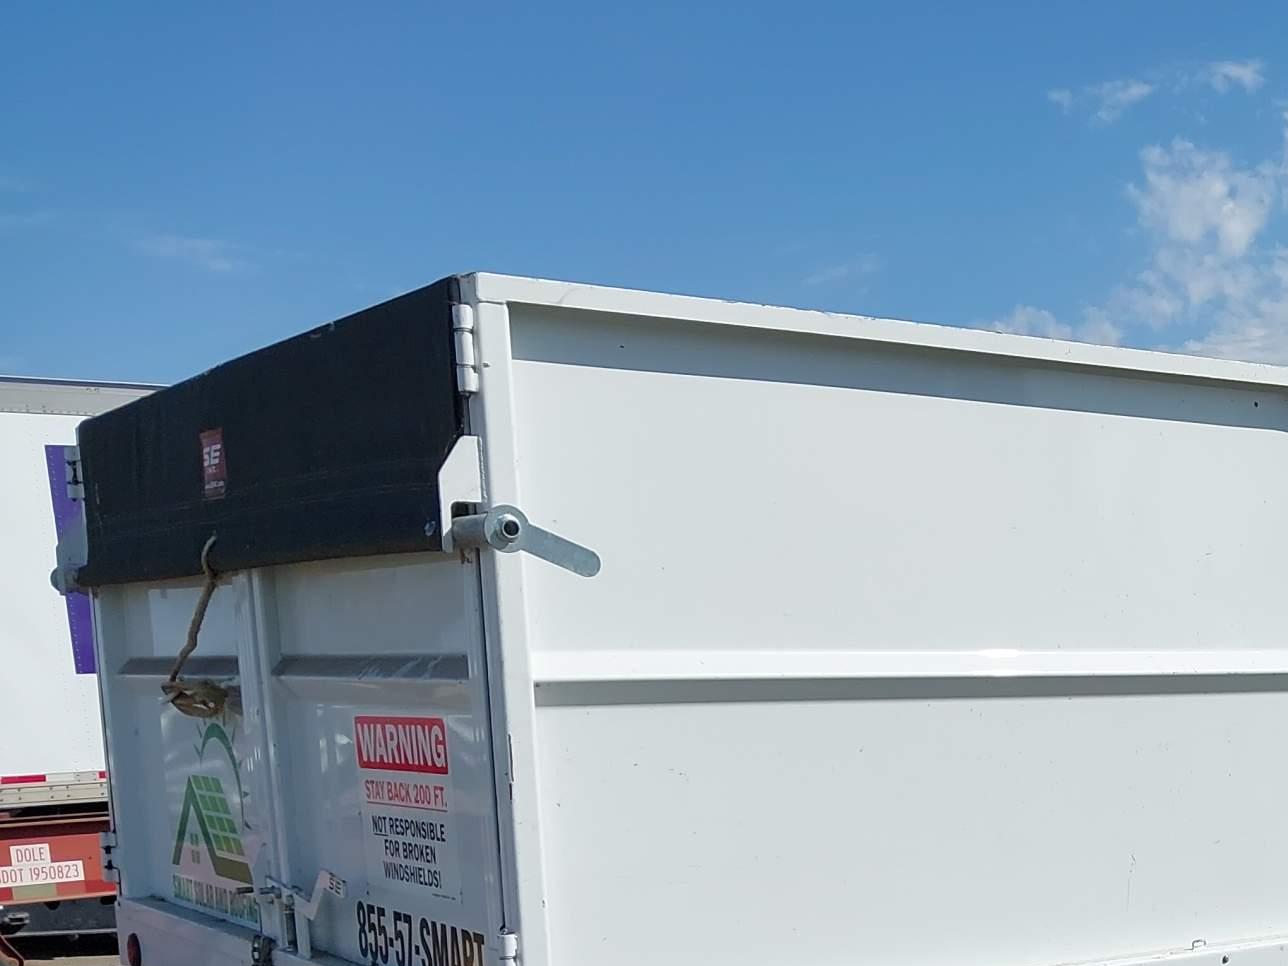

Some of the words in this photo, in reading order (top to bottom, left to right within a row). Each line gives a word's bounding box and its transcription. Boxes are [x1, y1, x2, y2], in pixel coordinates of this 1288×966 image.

[357, 723, 447, 768] WARNING
[365, 779, 385, 800] STAY
[387, 782, 411, 803] BACK
[413, 786, 431, 806] 200
[433, 787, 448, 808] FT.
[372, 815, 388, 833] NOT
[389, 819, 447, 842] RESPONSIBLE
[16, 847, 45, 863] DOLE
[384, 838, 401, 858] FOR
[402, 841, 437, 865] BROKEN
[0, 869, 23, 884] DOT
[29, 864, 80, 882] 1950823
[383, 861, 442, 889] WINDSHIELDS!
